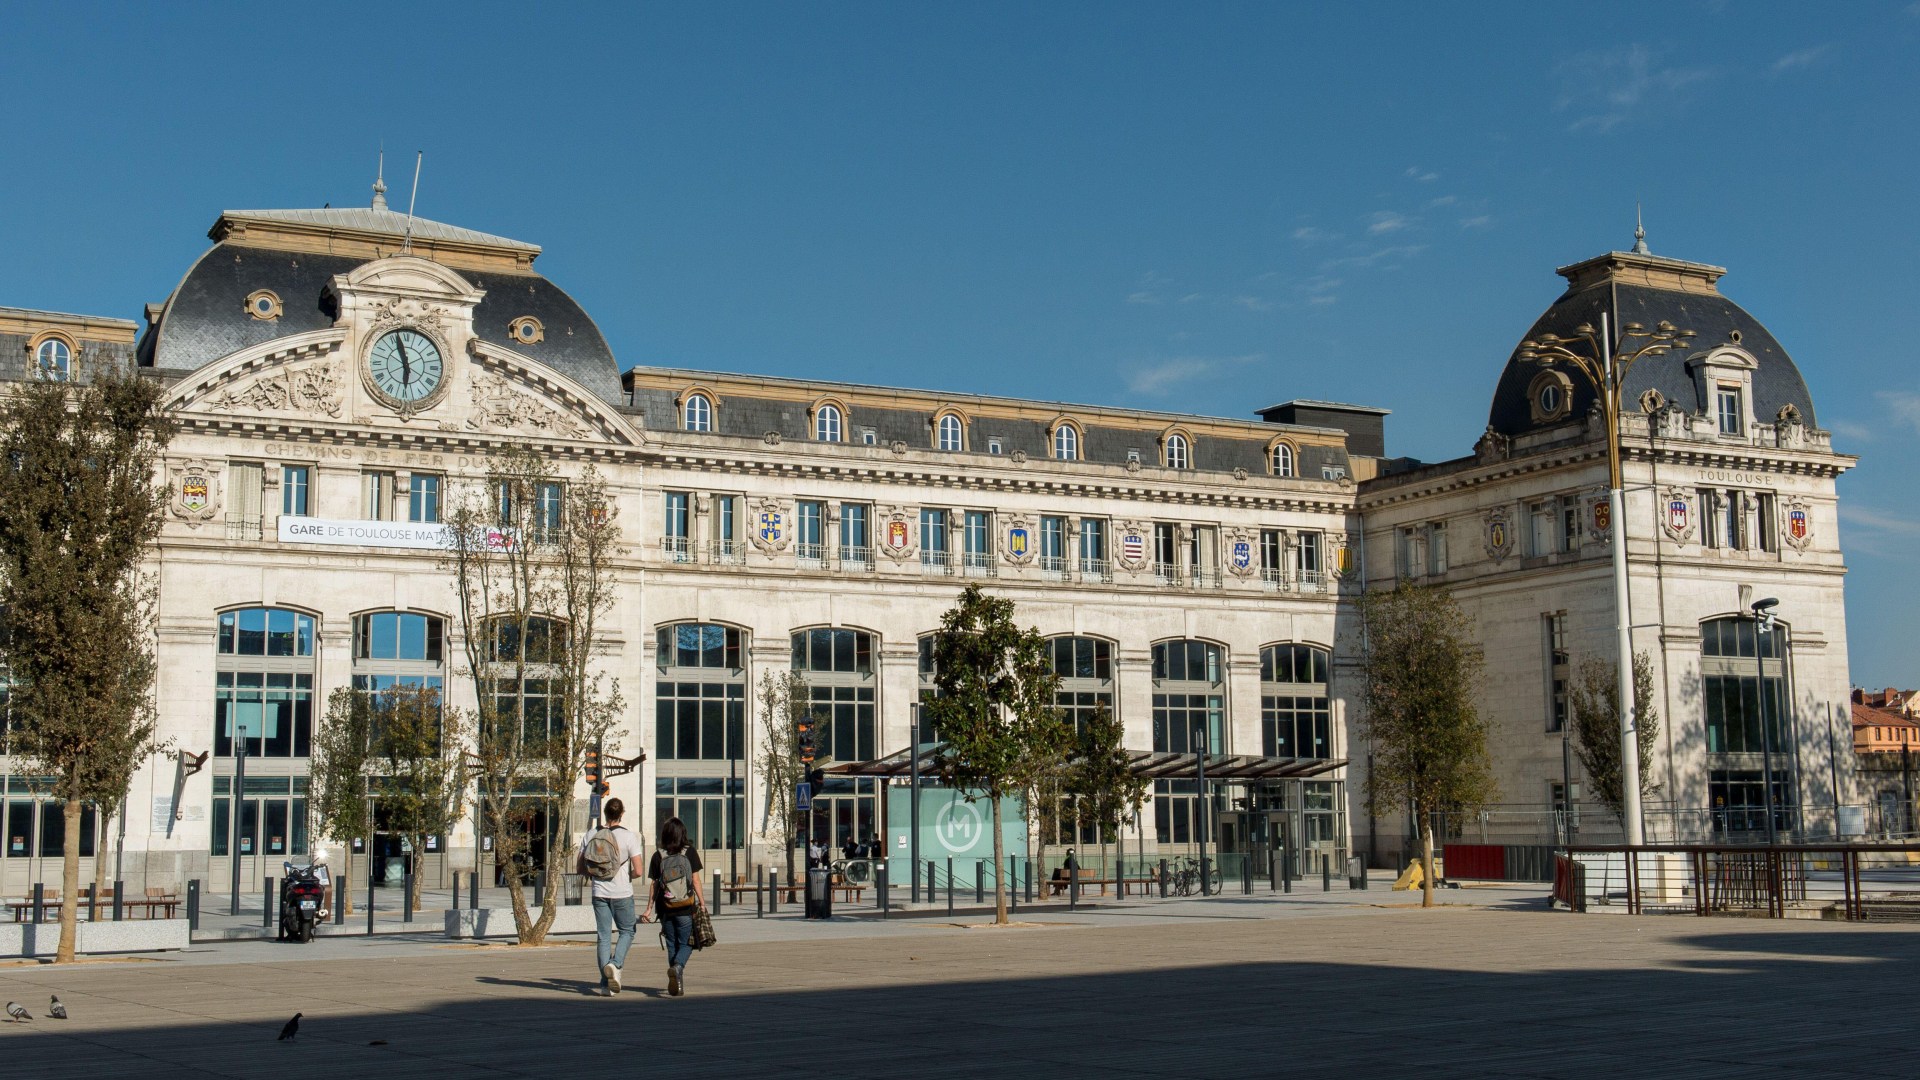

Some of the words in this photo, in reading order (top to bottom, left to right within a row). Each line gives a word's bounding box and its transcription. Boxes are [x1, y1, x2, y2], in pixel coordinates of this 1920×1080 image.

[264, 443, 352, 459] CHEMINS
[366, 450, 391, 463] DE
[405, 453, 444, 466] FER
[458, 456, 483, 468] DU
[1697, 470, 1773, 485] TOULOUSE
[289, 524, 324, 536] GARE
[328, 526, 345, 537] DE
[348, 527, 411, 540] TOULOUSE
